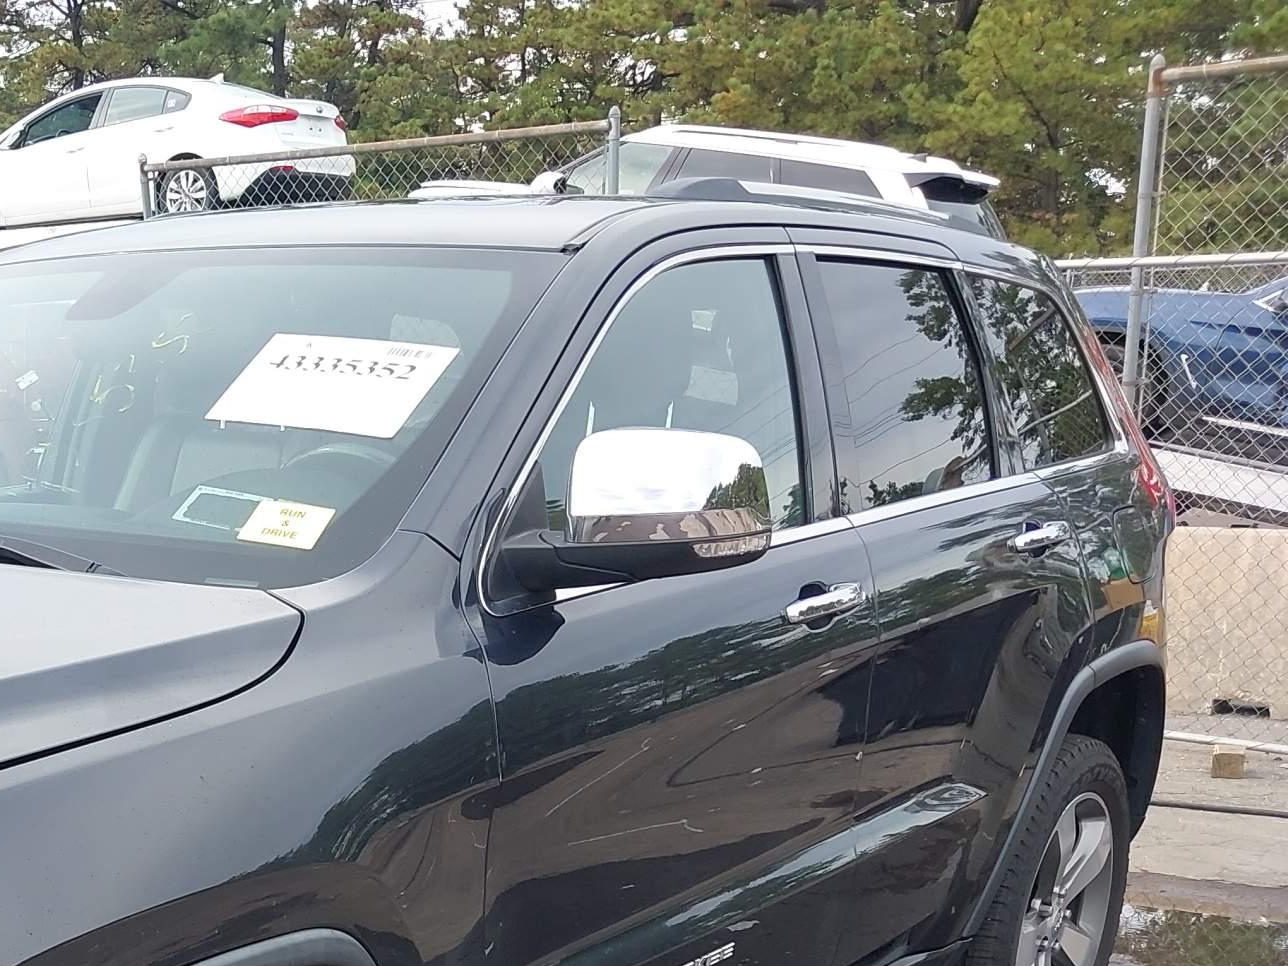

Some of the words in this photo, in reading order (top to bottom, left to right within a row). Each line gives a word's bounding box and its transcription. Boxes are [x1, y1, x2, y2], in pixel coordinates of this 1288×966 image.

[270, 354, 417, 380] 43335352
[280, 508, 307, 519] RUN
[261, 527, 298, 539] DRIVE
